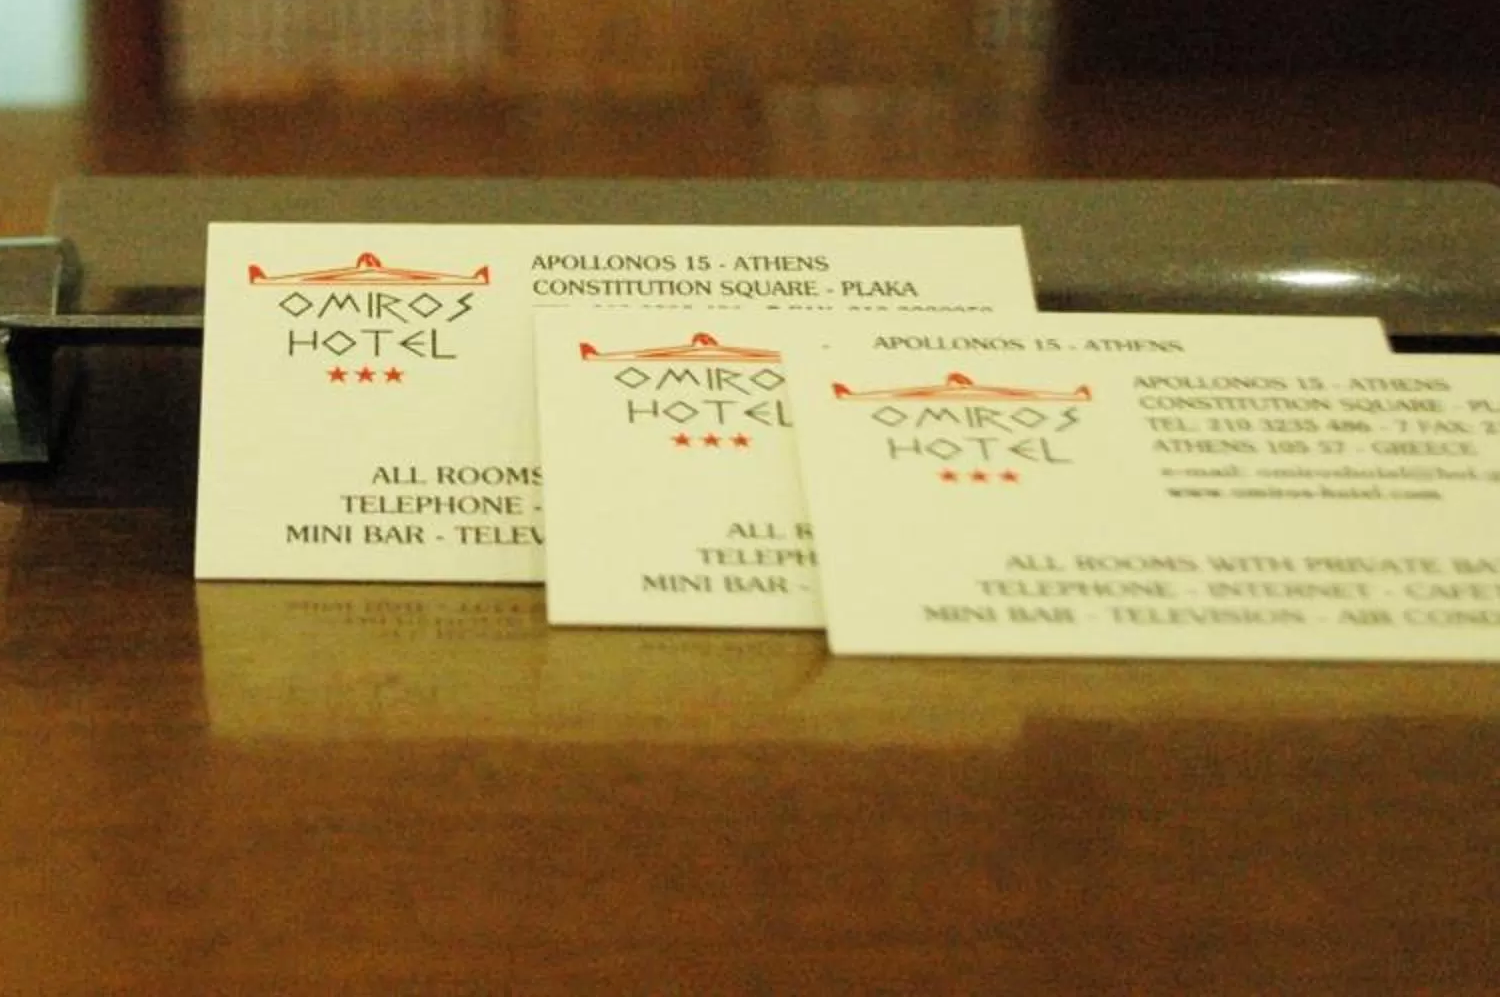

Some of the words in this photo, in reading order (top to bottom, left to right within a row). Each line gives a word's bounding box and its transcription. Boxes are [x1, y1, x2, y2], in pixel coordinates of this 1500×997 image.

[531, 254, 676, 271] APOLLONOS
[686, 255, 711, 271] 15
[734, 255, 829, 272] ATHENS
[533, 279, 712, 297] CONSTITUTION
[721, 279, 818, 299] SQUARE
[842, 280, 919, 297] PLAKA
[278, 291, 475, 324] OMIROS
[287, 328, 458, 360] HOTEL
[873, 335, 1025, 350] APOLLONOS
[1034, 337, 1061, 351] 15
[1084, 338, 1186, 353] ATHENS
[614, 366, 786, 396] OMIRO
[1133, 376, 1289, 392] APOLLONOS
[1349, 377, 1451, 393] ATHENS
[627, 399, 793, 428] HOTEL
[1138, 396, 1332, 412] CONSTITUTION
[1338, 398, 1444, 415] SQUARE
[871, 405, 1080, 433] OMIROS
[886, 437, 1074, 464] HOTEL
[1153, 439, 1257, 454] ATHENS
[1371, 440, 1478, 456] GREECE
[372, 466, 427, 485] ALL
[436, 466, 544, 486] ROOMS
[340, 495, 525, 515] TELEPHONE
[286, 524, 352, 544] MINI
[364, 525, 426, 545] BAR
[726, 522, 786, 540] ALL
[697, 547, 819, 567] TELEPH
[1005, 555, 1065, 573] ALL
[1074, 556, 1200, 573] ROOMS
[1206, 556, 1297, 573] WITH
[1302, 556, 1443, 574] PRIVATE
[641, 574, 713, 593] MINI
[724, 575, 789, 593] BAR
[975, 579, 1178, 598] TELEPHONE
[1206, 581, 1371, 599] INTERNET
[922, 605, 998, 623] MINI
[1006, 605, 1077, 624] BAR
[1110, 606, 1306, 626] TELEVISION
[1337, 608, 1395, 626] AIR
